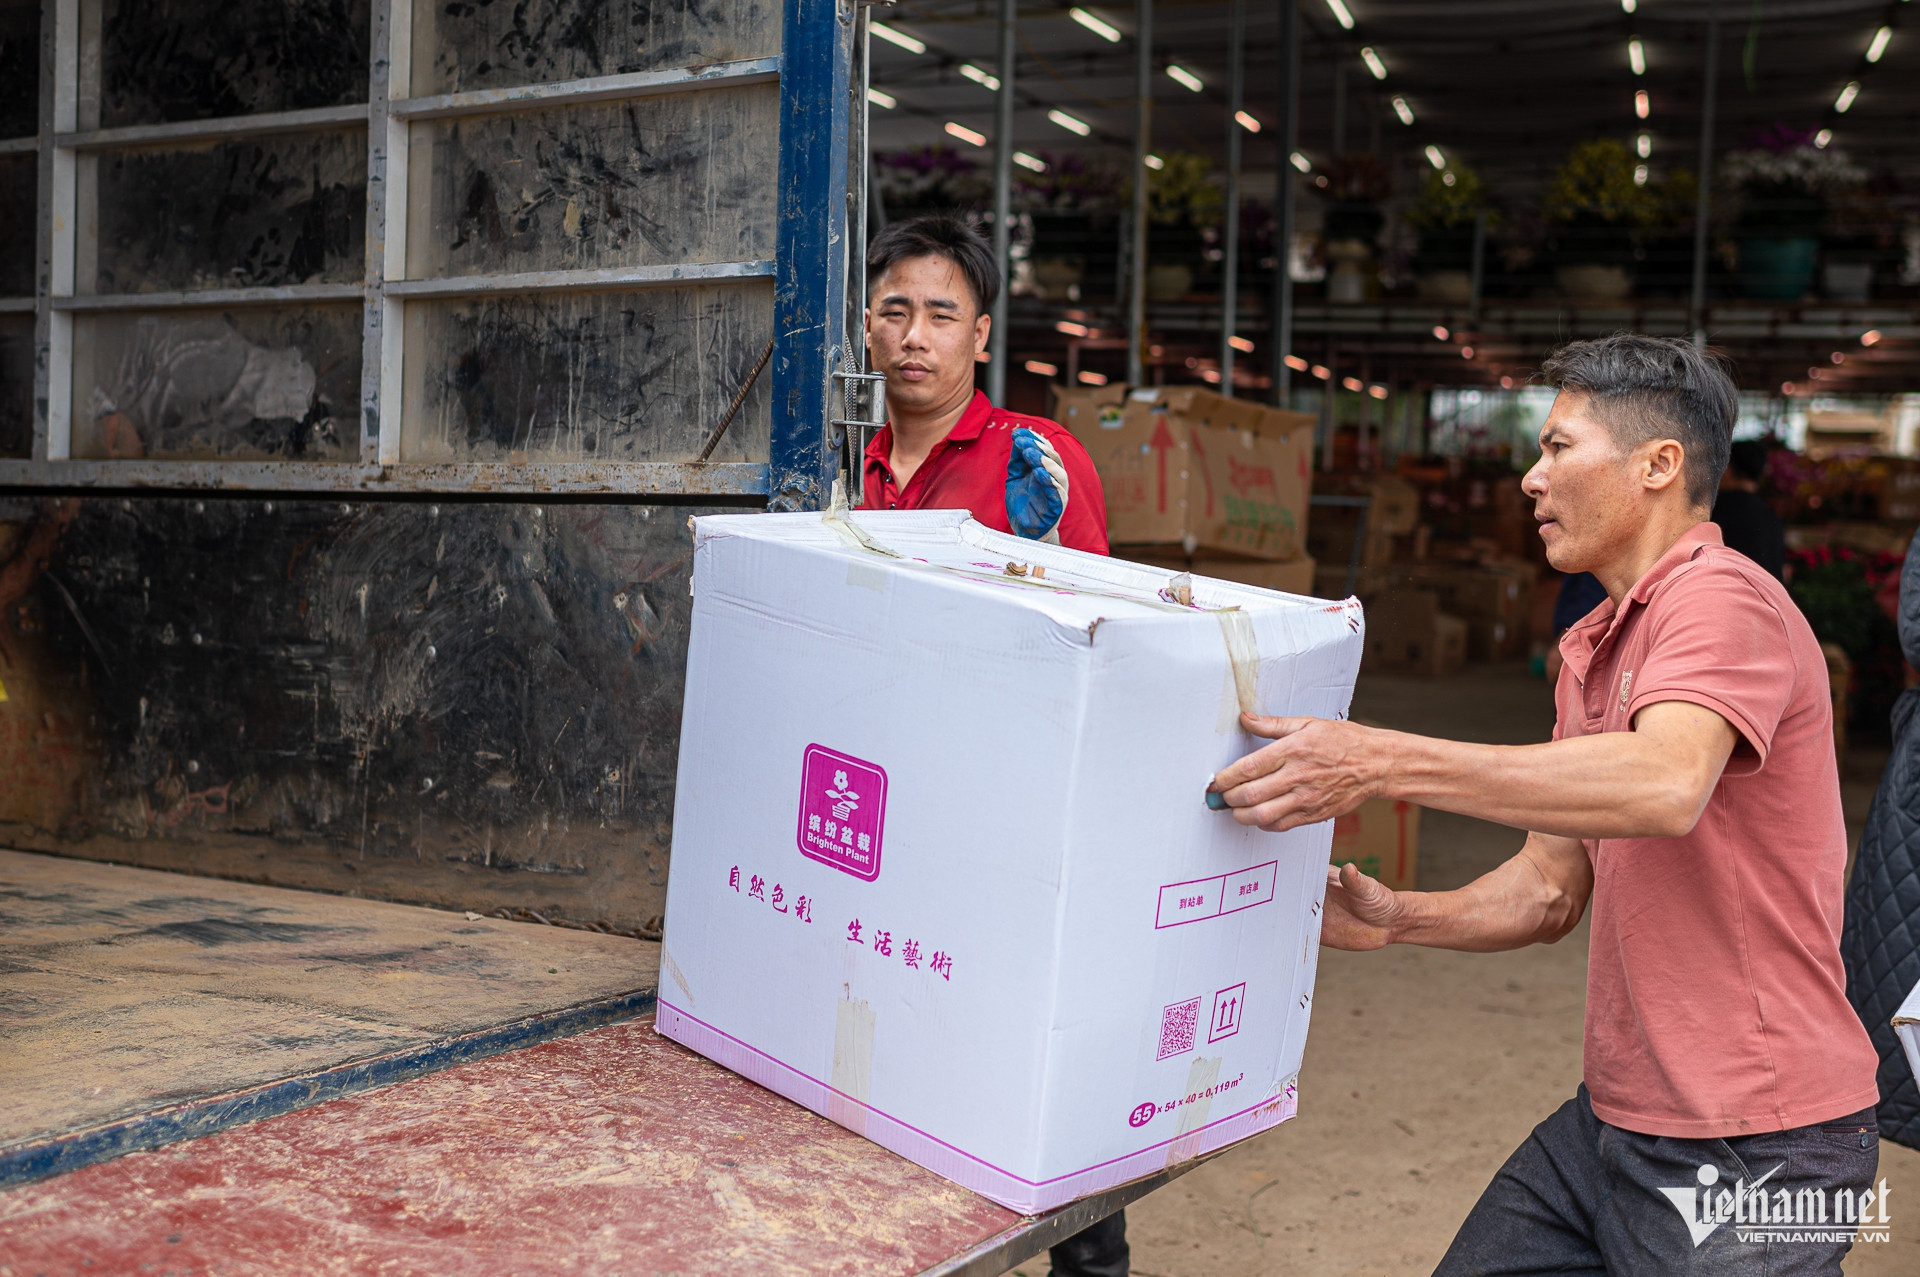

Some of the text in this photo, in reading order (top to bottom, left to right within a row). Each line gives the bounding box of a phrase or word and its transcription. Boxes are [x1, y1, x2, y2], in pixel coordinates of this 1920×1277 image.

[807, 832, 869, 864] Brighten Plant
[808, 813, 871, 852] 缤纷盆栽
[729, 865, 953, 981] 自然色彩 生活藝術
[1132, 1105, 1152, 1125] 55
[1165, 1100, 1176, 1112] 54
[1185, 1093, 1196, 1105] 40
